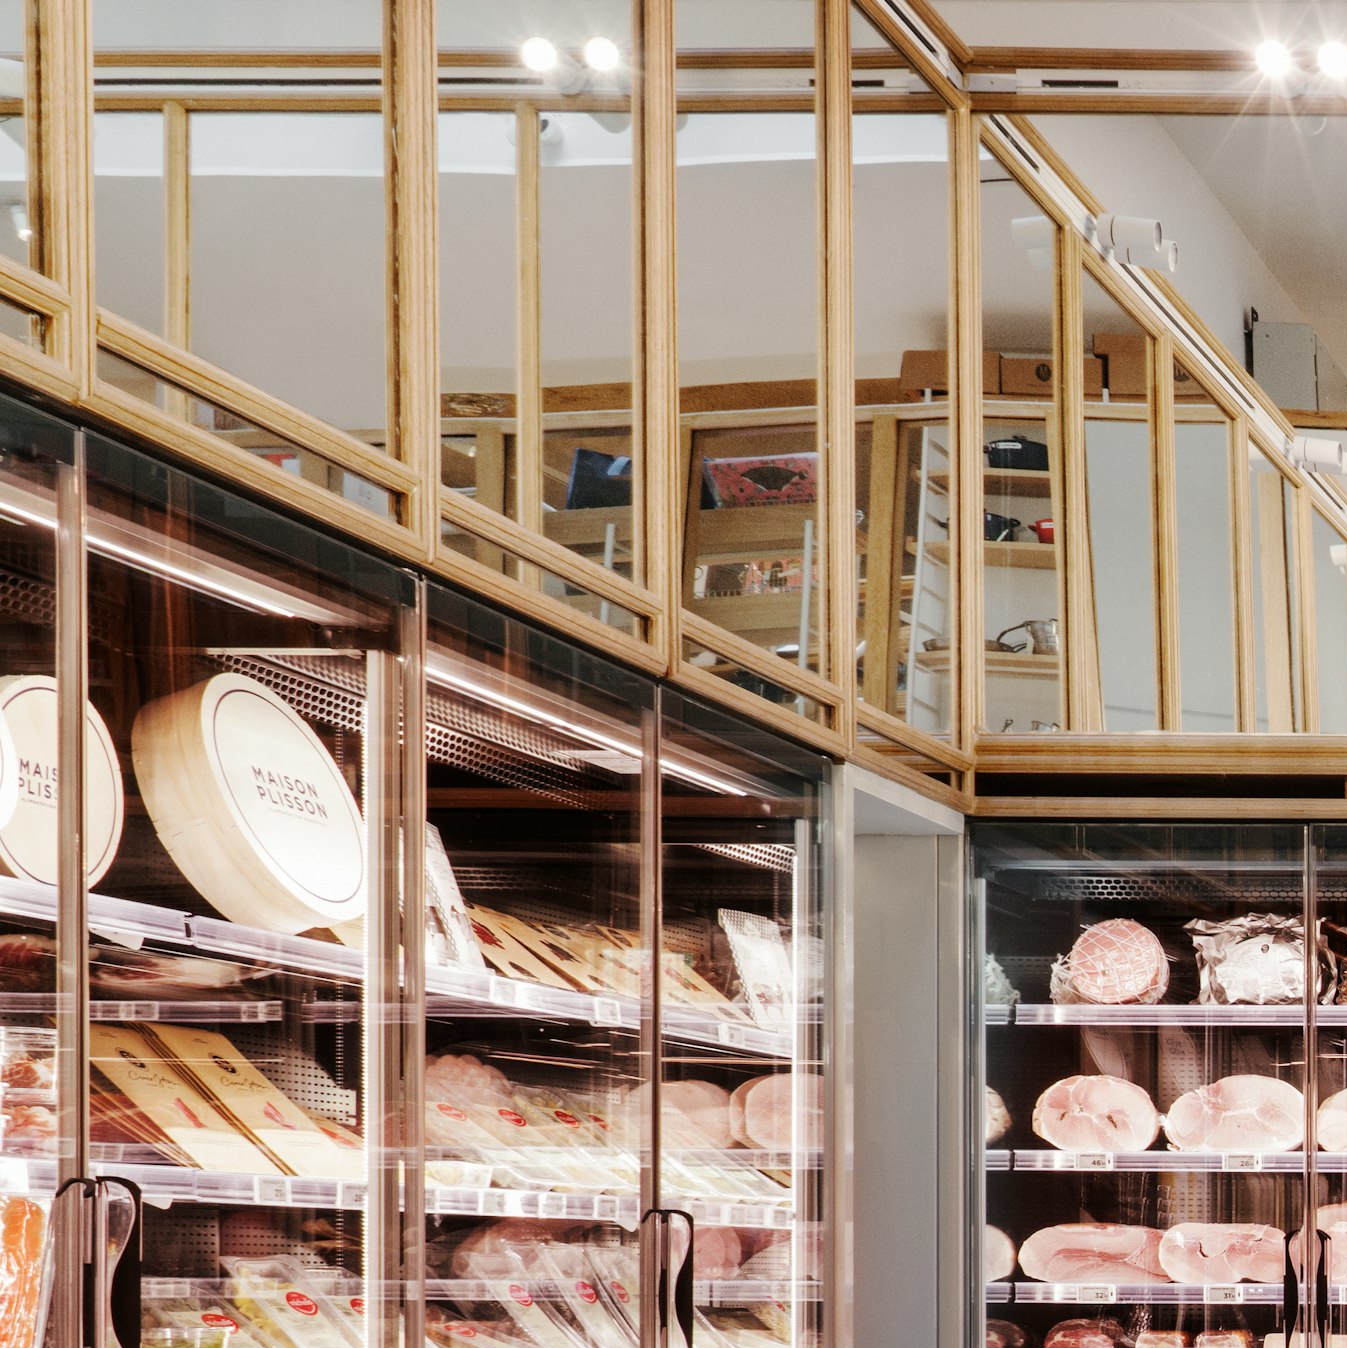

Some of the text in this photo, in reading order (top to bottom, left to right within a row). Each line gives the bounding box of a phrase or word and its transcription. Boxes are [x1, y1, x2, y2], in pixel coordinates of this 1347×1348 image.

[20, 757, 57, 782] MAIS
[251, 765, 319, 799] MAISON
[256, 785, 329, 819] PLISSON
